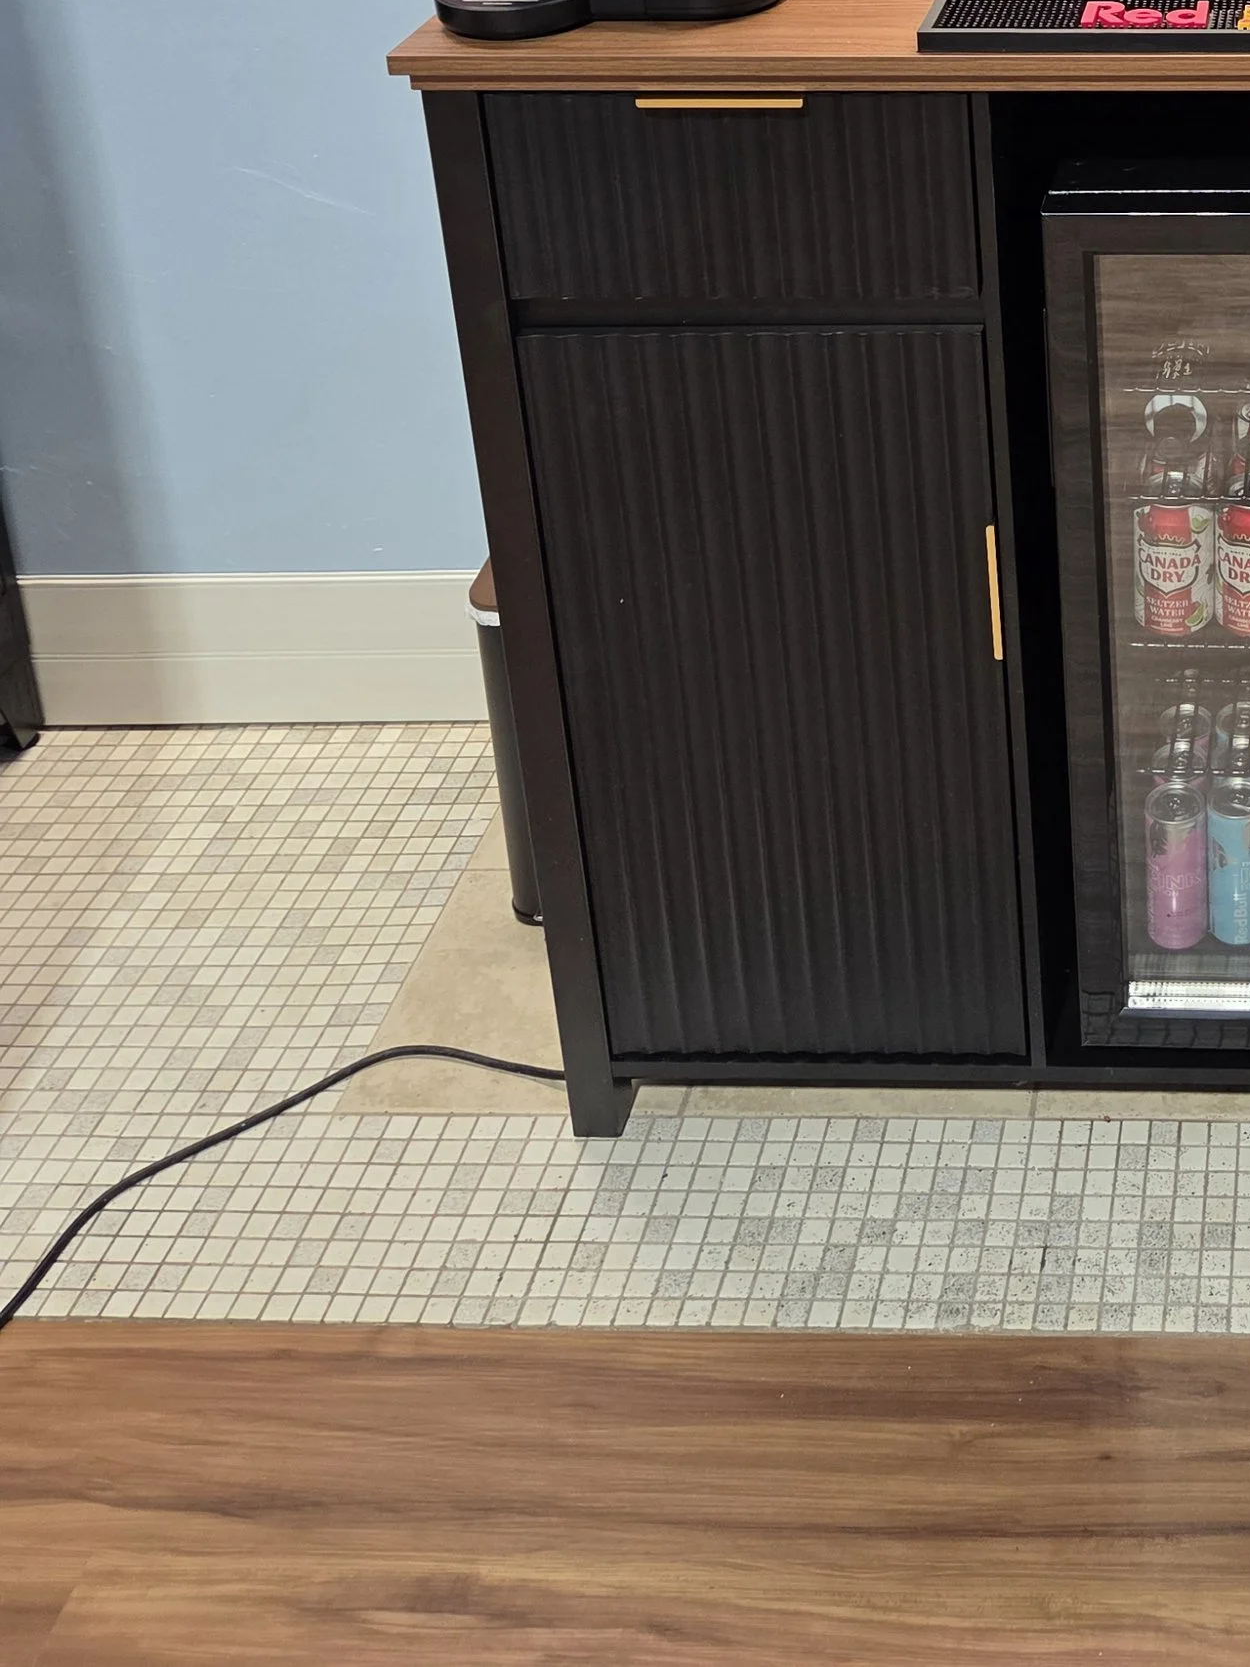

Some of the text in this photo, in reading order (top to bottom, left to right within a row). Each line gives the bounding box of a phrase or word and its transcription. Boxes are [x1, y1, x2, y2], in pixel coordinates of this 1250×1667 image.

[1081, 0, 1209, 28] Red
[1139, 547, 1201, 569] CANADA
[1151, 570, 1184, 583] DRY
[1146, 594, 1189, 608] SELTZER
[1150, 605, 1185, 617] WATER
[1233, 892, 1249, 944] Red Bull
